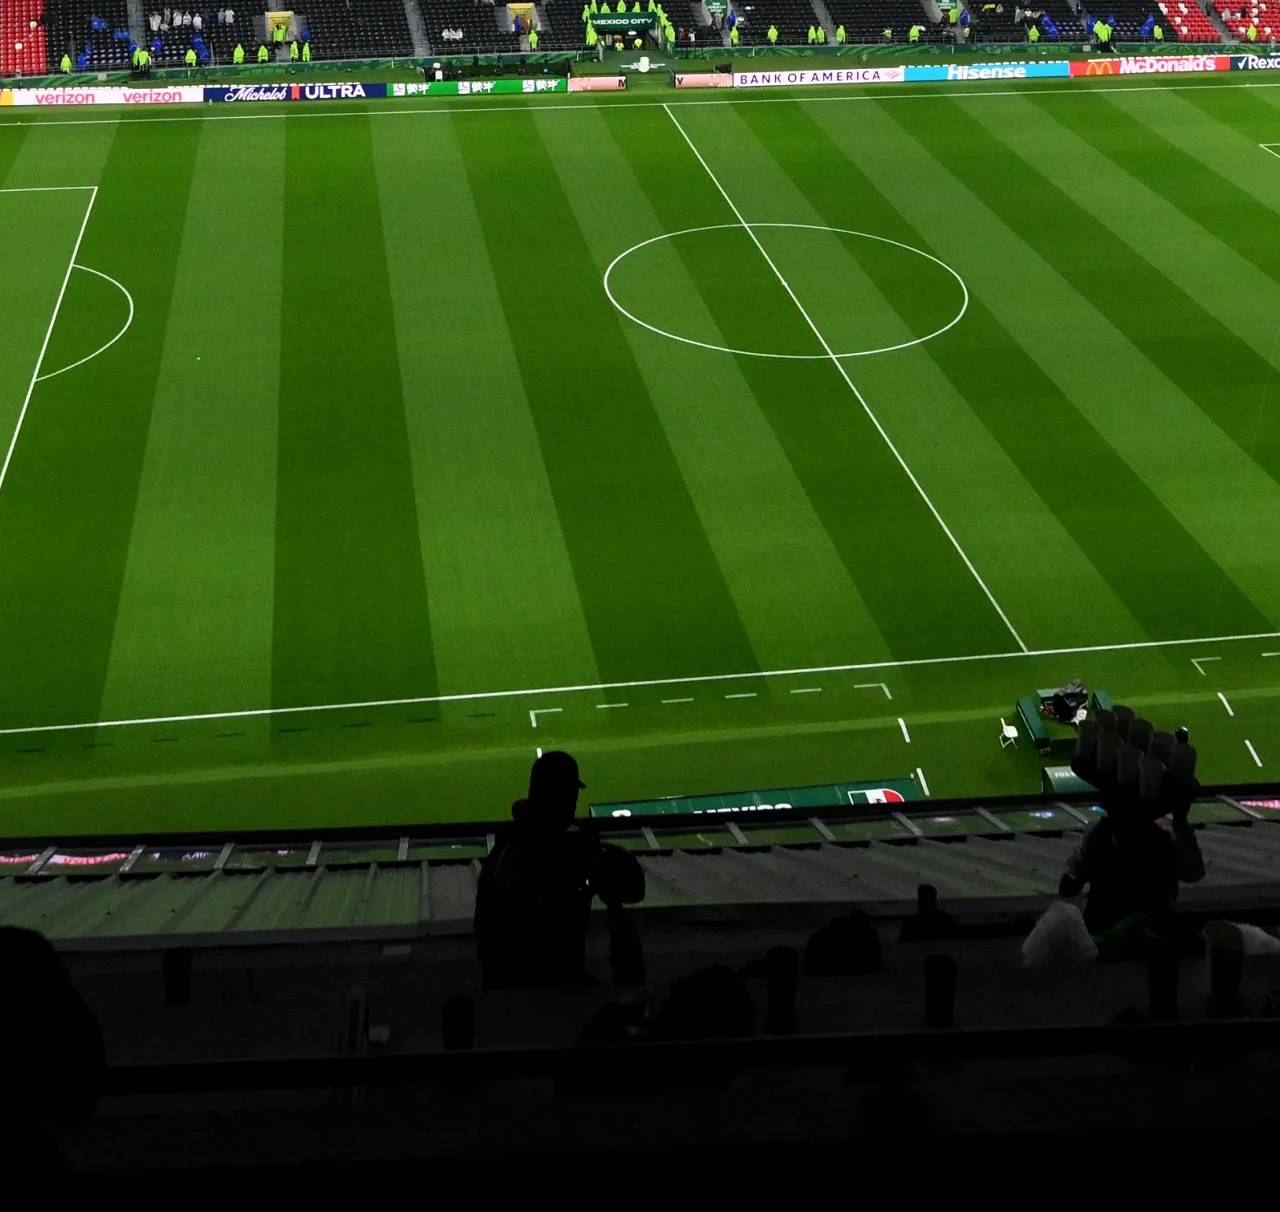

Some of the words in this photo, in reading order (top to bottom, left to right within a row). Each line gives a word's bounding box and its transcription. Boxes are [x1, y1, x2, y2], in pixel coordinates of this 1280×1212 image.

[593, 18, 627, 26] MEXICO
[628, 17, 654, 25] CITY
[1120, 56, 1216, 73] McDonald's
[740, 73, 782, 85] BANK
[787, 72, 805, 83] OF
[809, 69, 881, 83] AMERICA
[948, 65, 1027, 80] Hisense
[35, 91, 95, 104] verizon
[123, 89, 183, 103] verizon
[224, 86, 287, 102] Michelob
[305, 85, 366, 99] ULTRA
